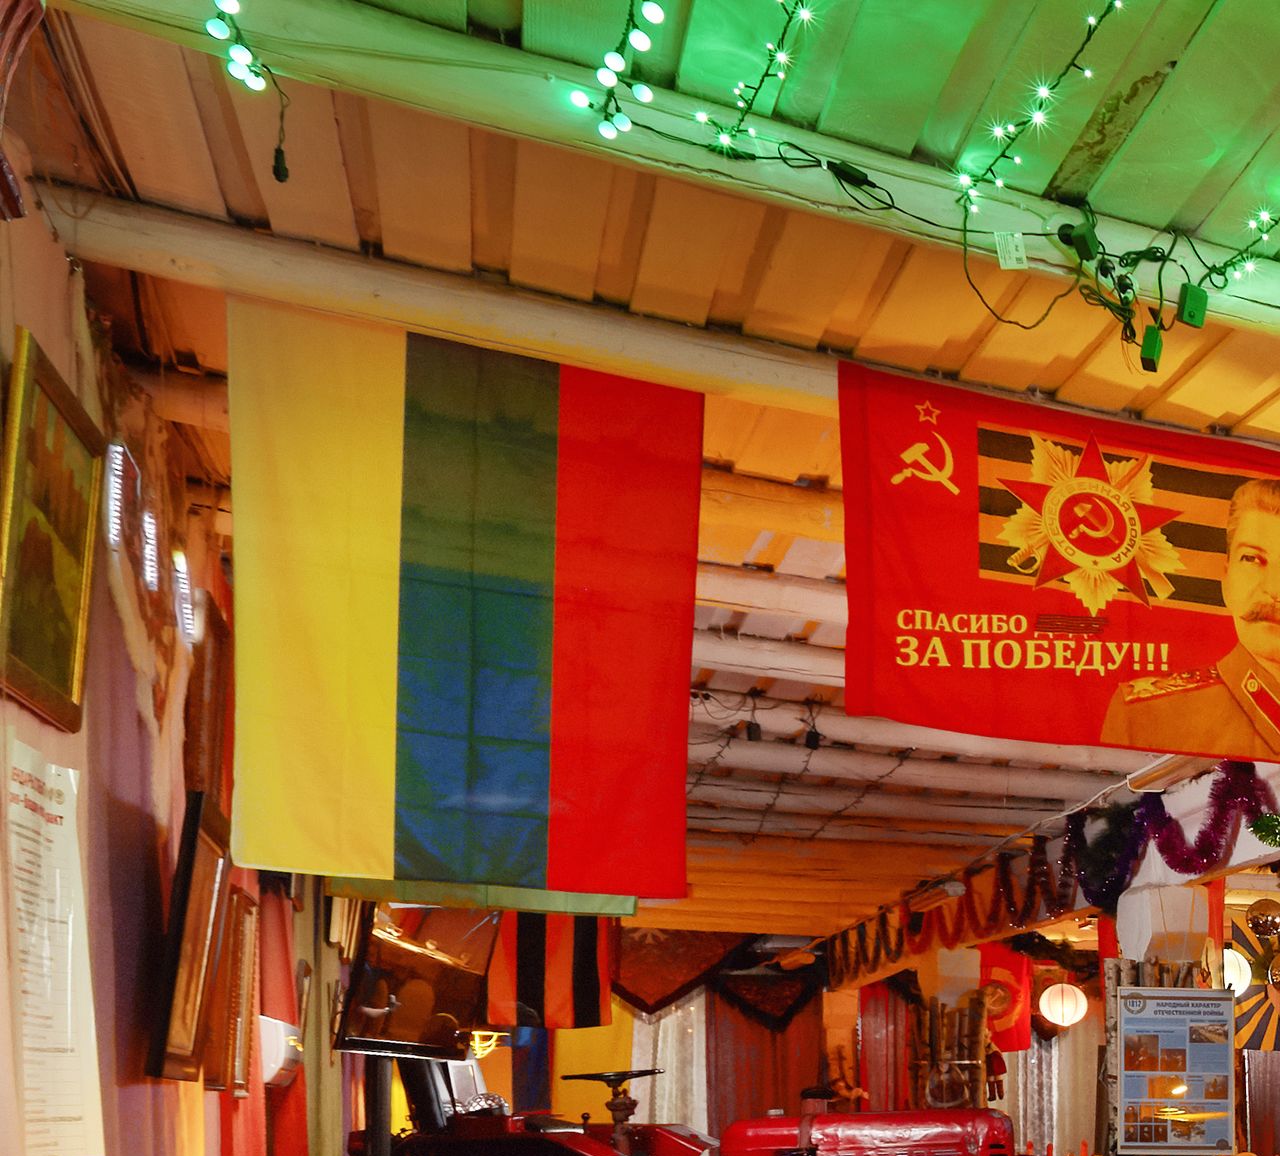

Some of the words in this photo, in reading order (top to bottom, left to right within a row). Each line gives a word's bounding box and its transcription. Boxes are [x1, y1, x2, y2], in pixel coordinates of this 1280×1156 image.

[1046, 481, 1131, 557] ОТЕЧЕСТВЕННАЯ
[896, 609, 1028, 635] СПАСИБО
[895, 635, 951, 667] ЗА
[961, 639, 1169, 677] ПОБЕДУ!!!
